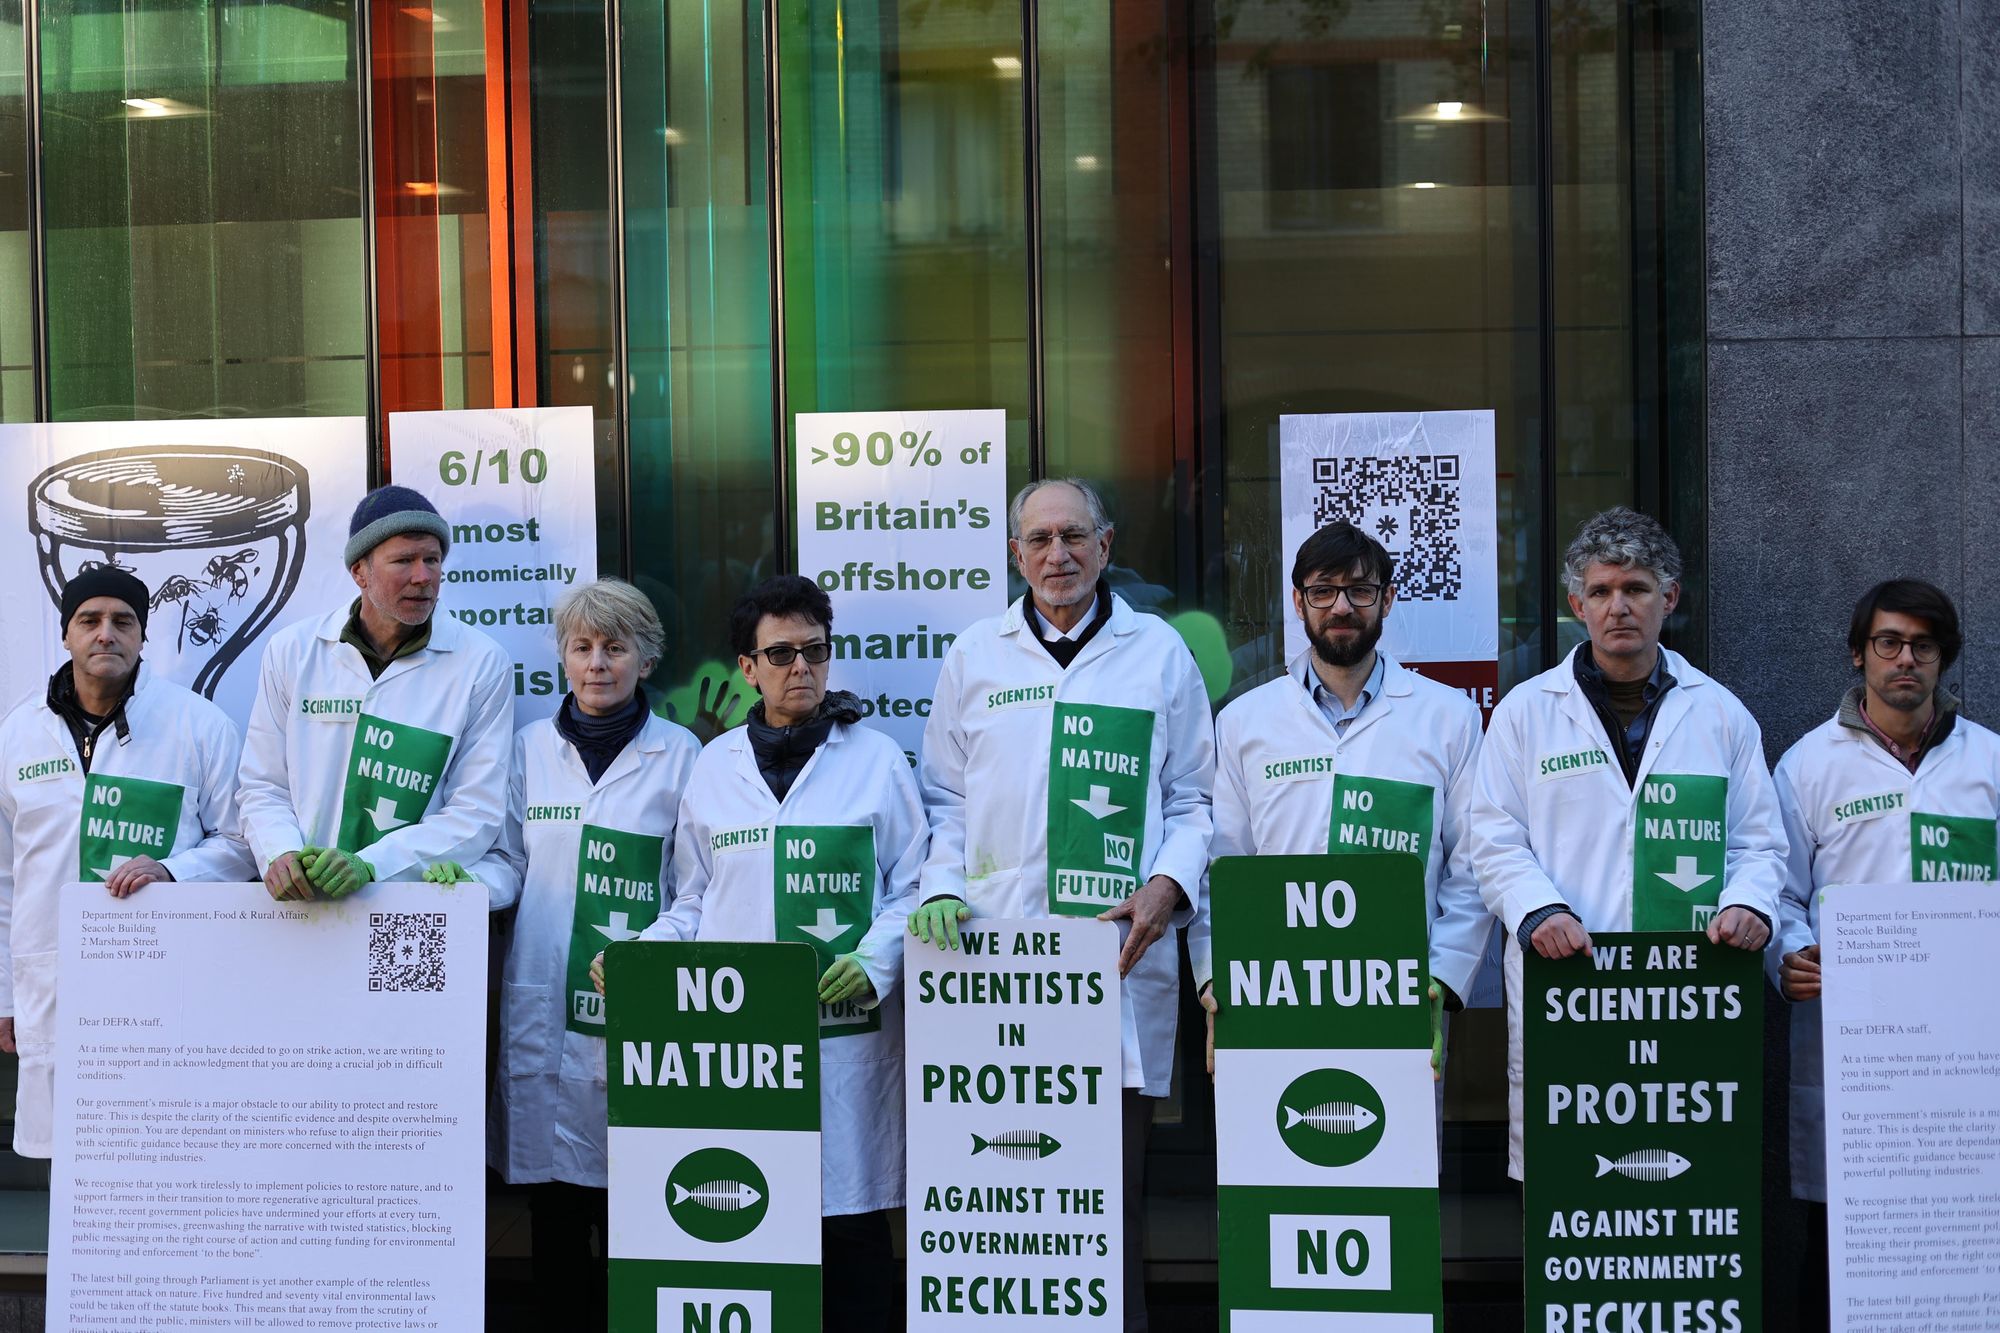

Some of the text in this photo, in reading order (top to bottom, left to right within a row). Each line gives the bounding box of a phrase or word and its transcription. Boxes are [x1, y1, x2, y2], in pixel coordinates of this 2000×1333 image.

[811, 430, 991, 467] >90% of
[439, 448, 547, 486] 6/10
[815, 499, 991, 531] Britain’s
[452, 517, 540, 543] most
[817, 561, 991, 592] offshore
[302, 698, 362, 715] SCIENTIST
[988, 685, 1055, 708] SCIENTIST
[364, 725, 394, 750] NO
[1063, 715, 1094, 737] NO
[18, 758, 76, 781] SCIENTIST
[1061, 748, 1140, 776] NATURE
[1265, 757, 1333, 780] SCIENTIST
[1541, 750, 1608, 775] SCIENTIST
[357, 756, 433, 794] NATURE
[92, 784, 122, 807] NO
[1342, 789, 1374, 812] NO
[1644, 782, 1676, 805] NO
[526, 806, 581, 822] CIENTIST
[1835, 792, 1904, 821] SCIENTIST
[87, 817, 165, 847] NATURE
[711, 827, 769, 851] SCIENTIST
[1339, 823, 1420, 853] NATURE
[1644, 818, 1721, 842] NATURE
[1920, 825, 1950, 848] NO
[587, 839, 616, 863] NO
[785, 838, 816, 860] NO
[1106, 838, 1131, 862] NO
[785, 872, 861, 894] NATURE
[1921, 860, 1991, 882] NATURE
[584, 873, 654, 902] NATURE
[1057, 873, 1135, 900] FUTURE
[82, 909, 309, 922] Department for Environment, Food & Rural Affairs
[1285, 880, 1357, 929] NO
[81, 923, 157, 936] Seacole Building
[1836, 912, 1892, 924] Department
[1894, 911, 1908, 921] for
[81, 936, 159, 947] 2 Marsham Street
[1836, 925, 1918, 937] Seacole Building
[80, 950, 168, 960] London SW1P 4DF
[960, 932, 1061, 956] WE ARE
[1837, 939, 1921, 951] 2 Marsham Street
[1593, 945, 1698, 971] WE ARE
[1837, 952, 1931, 965] London SW1P 4DF
[676, 966, 745, 1014] NO
[918, 971, 1104, 1005] SCIENTISTS
[1229, 958, 1420, 1007] NATURE
[1545, 985, 1742, 1021] SCIENTISTS
[79, 1017, 163, 1027] Dear DEFRA staff,
[1840, 1025, 1864, 1036] Dear
[1865, 1024, 1905, 1035] DEFRA
[998, 1023, 1025, 1047] IN
[78, 1044, 89, 1053] At
[99, 1044, 119, 1053] time
[121, 1044, 145, 1054] when
[147, 1046, 171, 1056] many
[174, 1044, 185, 1054] of
[186, 1047, 204, 1057] you
[205, 1044, 228, 1055] have
[229, 1045, 265, 1055] decided
[267, 1047, 277, 1055] to
[278, 1047, 291, 1057] go
[292, 1047, 304, 1055] on
[306, 1045, 332, 1055] strike
[334, 1047, 366, 1056] action,
[367, 1048, 381, 1056] we
[383, 1048, 398, 1056] are
[400, 1046, 433, 1058] writing
[436, 1047, 446, 1056] to
[1628, 1039, 1658, 1065] IN
[1841, 1054, 1854, 1064] At
[1855, 1056, 1861, 1064] a
[1863, 1055, 1885, 1064] time
[1887, 1053, 1914, 1063] when
[1916, 1054, 1942, 1065] many
[1944, 1052, 1955, 1062] of
[1957, 1053, 1976, 1064] you
[76, 1070, 126, 1080] conditions.
[78, 1059, 94, 1068] you
[96, 1059, 106, 1067] in
[108, 1059, 141, 1069] support
[143, 1057, 160, 1067] and
[162, 1058, 171, 1067] in
[173, 1058, 249, 1070] acknowledgment
[251, 1058, 269, 1068] that
[271, 1061, 288, 1071] you
[306, 1059, 333, 1071] doing
[335, 1061, 341, 1069] a
[342, 1059, 374, 1069] crucial
[375, 1059, 392, 1071] job
[394, 1059, 404, 1069] in
[405, 1059, 443, 1069] difficult
[622, 1041, 804, 1090] NATURE
[923, 1064, 1102, 1105] PROTEST
[1547, 1081, 1739, 1125] PROTEST
[74, 1151, 206, 1164] powerful polluting industries.
[1843, 1167, 1886, 1181] powerful
[1888, 1166, 1932, 1180] polluting
[923, 1186, 1104, 1215] AGAINST THE
[1548, 1208, 1739, 1239] AGAINST THE
[920, 1230, 1108, 1257] GOVERNMENT’S
[1297, 1228, 1369, 1277] NO
[1544, 1253, 1743, 1281] GOVERNMENT’S
[920, 1276, 1108, 1317] RECKLESS
[683, 1302, 752, 1333] NO
[1545, 1299, 1742, 1333] RECKLESS
